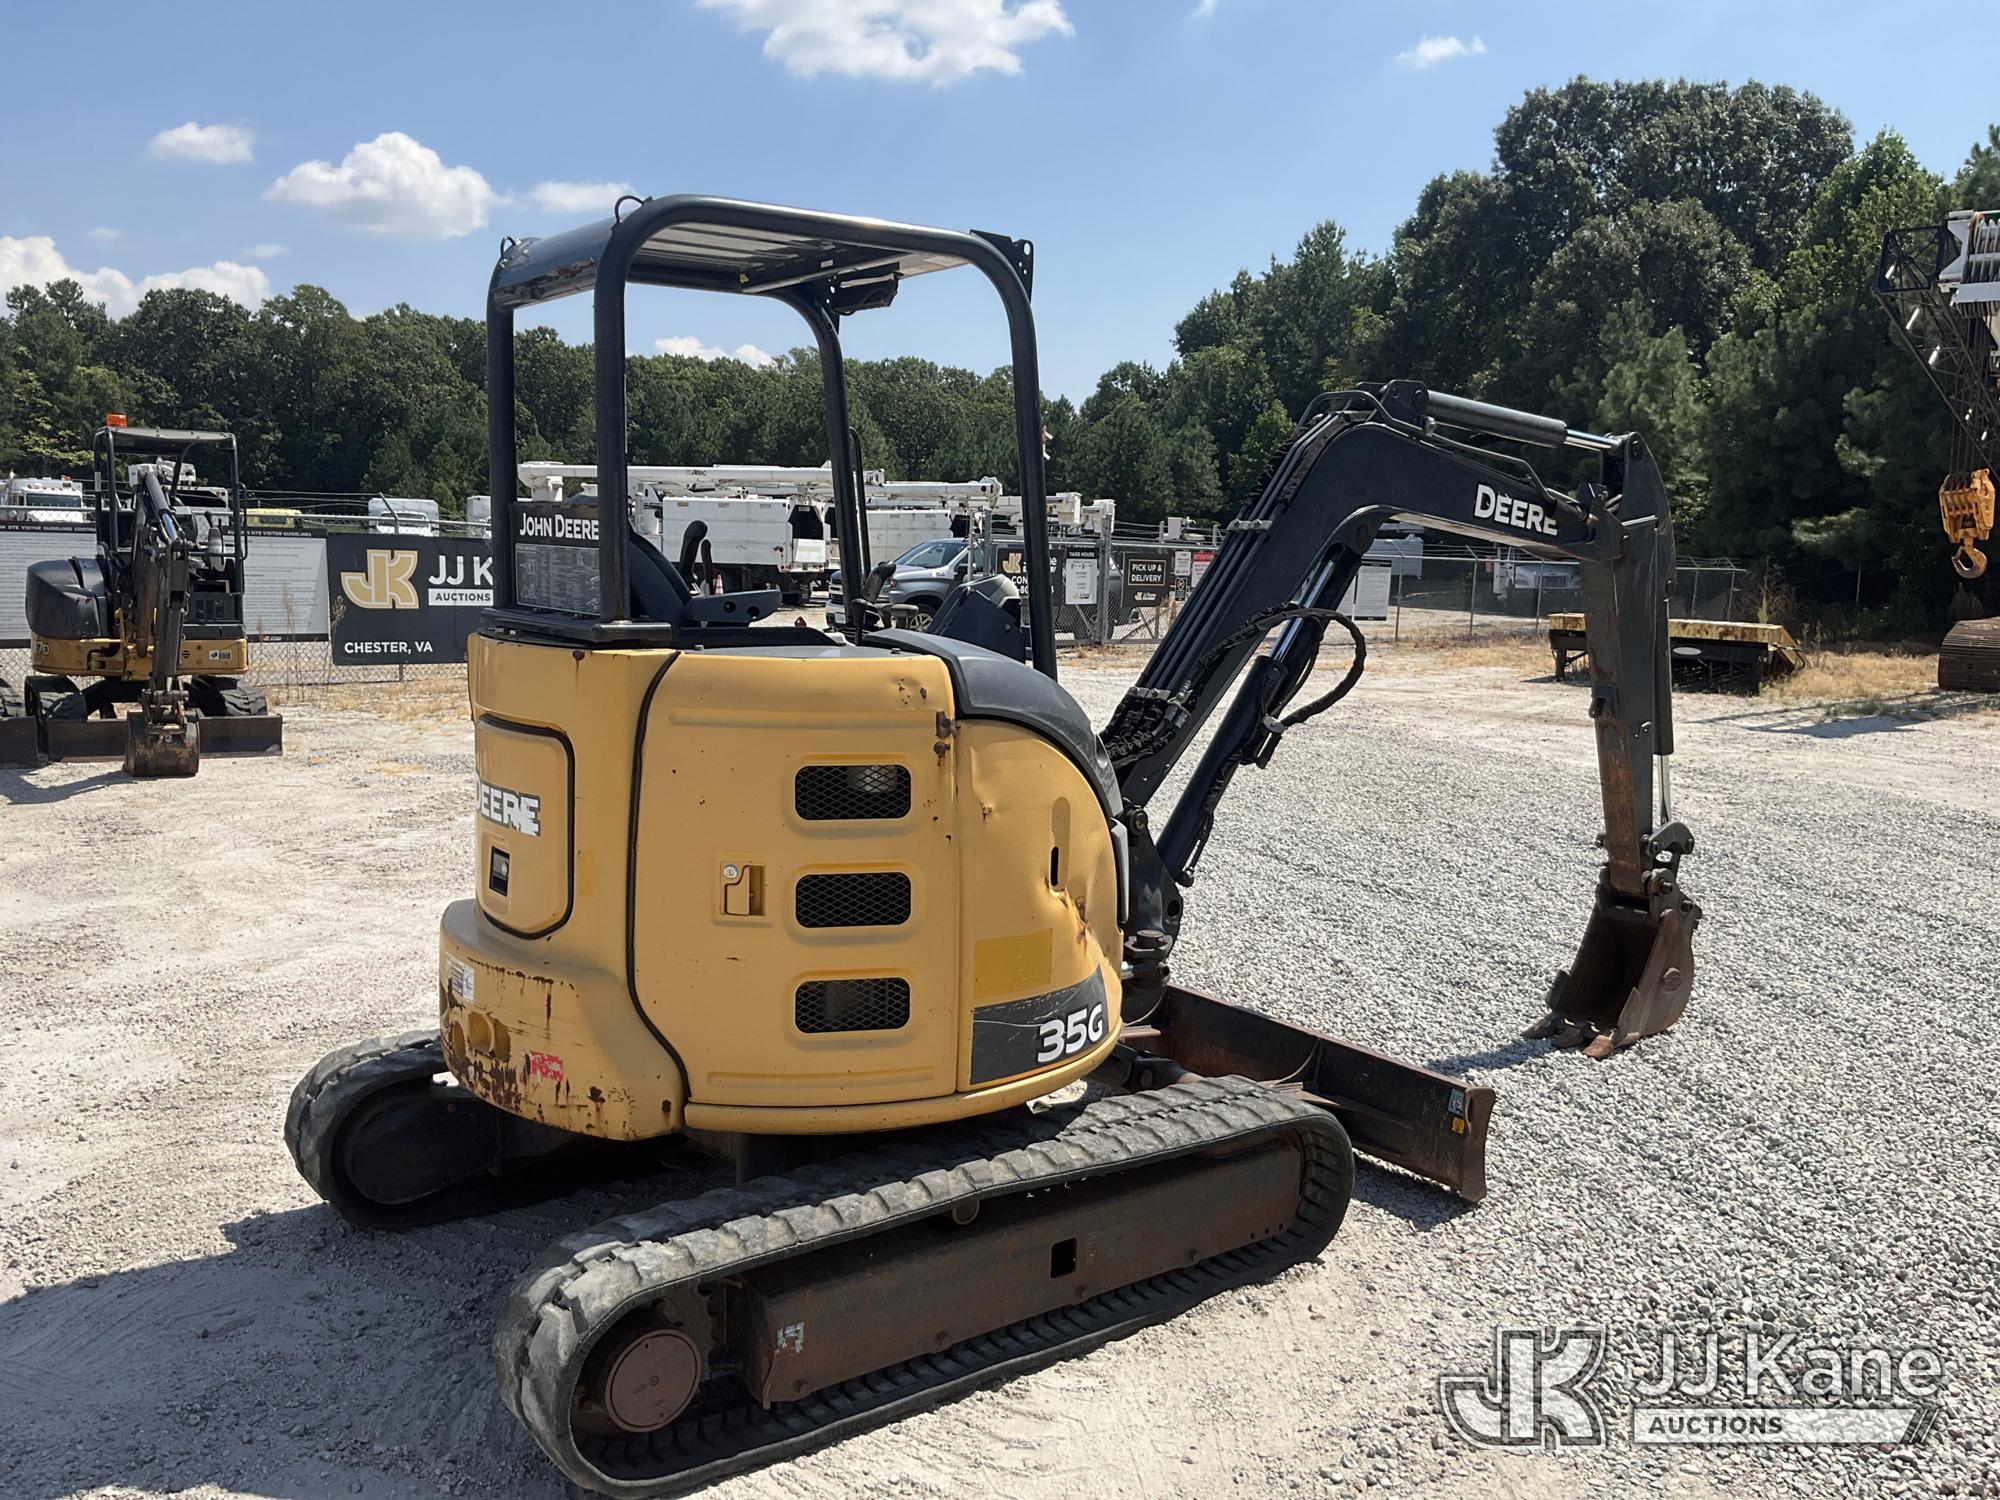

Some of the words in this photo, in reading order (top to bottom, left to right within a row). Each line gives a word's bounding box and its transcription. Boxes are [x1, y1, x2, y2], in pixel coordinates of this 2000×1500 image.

[1474, 483, 1558, 536] DEERE
[519, 512, 552, 537] JOHN
[554, 513, 599, 540] DEERE
[1132, 563, 1146, 571] PICK
[1147, 564, 1157, 572] UP
[1157, 564, 1162, 572] &
[340, 548, 420, 609] JK
[1131, 574, 1162, 582] DELIVERY
[435, 592, 491, 602] AUCTIONS
[344, 641, 411, 654] CHESTER,
[415, 641, 433, 652] VA
[1037, 1003, 1103, 1063] 35G
